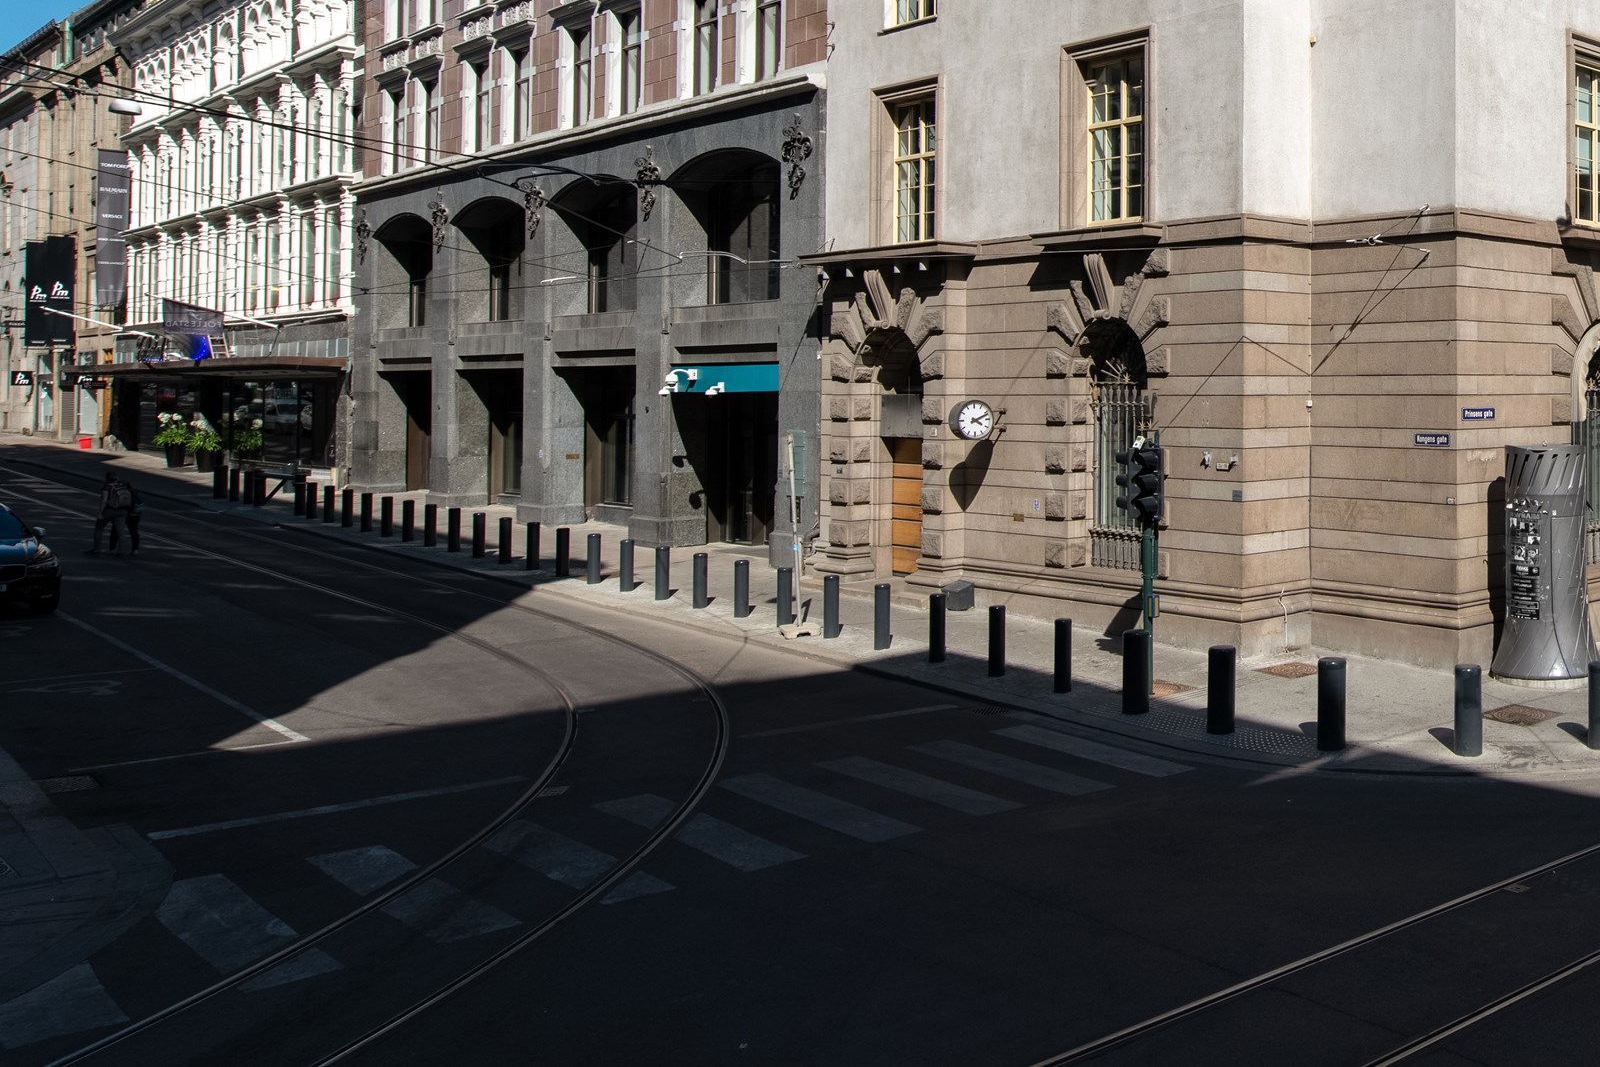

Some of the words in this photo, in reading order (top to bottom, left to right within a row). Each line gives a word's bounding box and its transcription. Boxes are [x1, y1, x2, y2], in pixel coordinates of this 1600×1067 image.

[1464, 410, 1483, 418] Prinsens
[1483, 410, 1493, 419] gate
[1416, 435, 1435, 444] Kongens
[1436, 436, 1447, 445] gate
